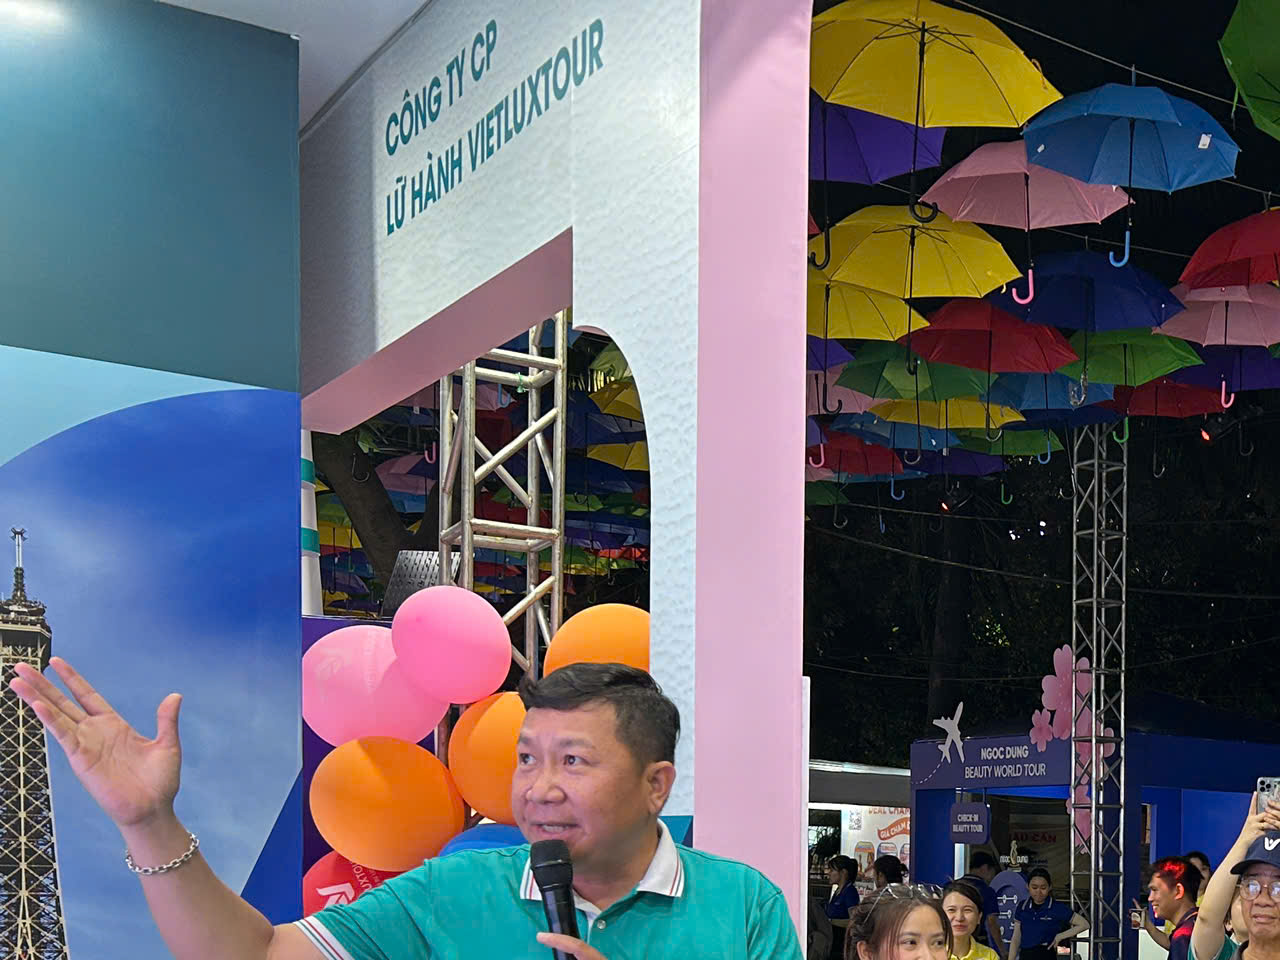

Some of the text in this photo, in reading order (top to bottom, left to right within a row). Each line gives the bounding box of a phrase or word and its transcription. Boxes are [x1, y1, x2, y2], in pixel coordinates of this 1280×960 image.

[385, 19, 497, 156] CÔNG TY CP
[386, 19, 604, 236] LỮ HÀNH VIETLUXTOUR
[1005, 745, 1029, 758] DUNG
[965, 763, 1046, 778] BEAUTY WORLD TOUR
[952, 824, 983, 832] BEAUTY TOUR
